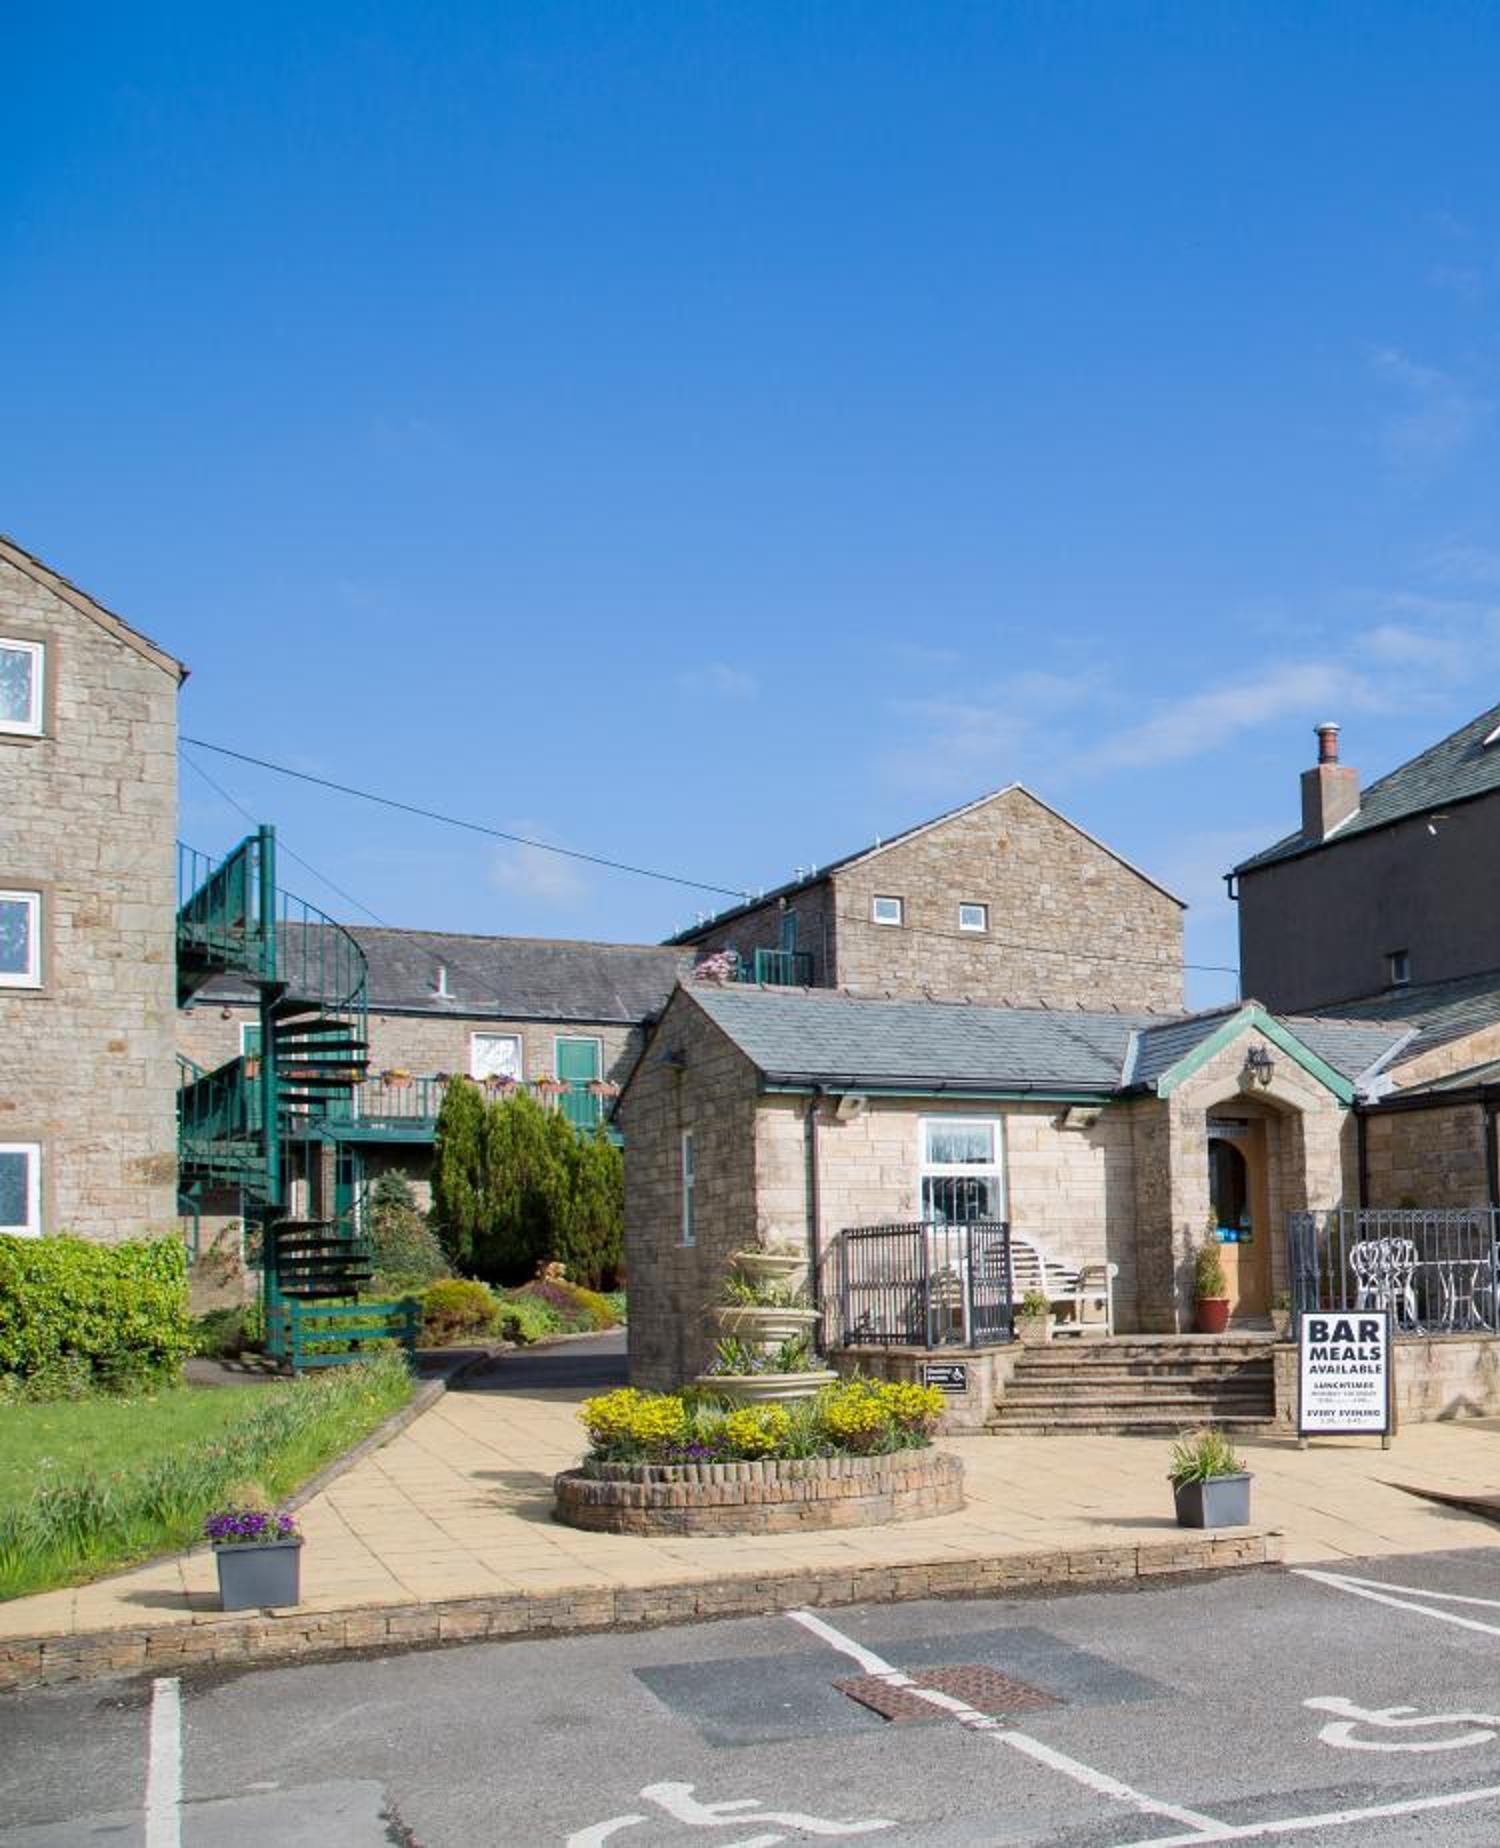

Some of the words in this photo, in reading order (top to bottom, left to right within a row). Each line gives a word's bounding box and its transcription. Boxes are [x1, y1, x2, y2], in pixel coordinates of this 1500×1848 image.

[1309, 1320, 1380, 1342] BAR
[1309, 1346, 1382, 1361] MEALS
[1309, 1364, 1382, 1374] AVAILABLE
